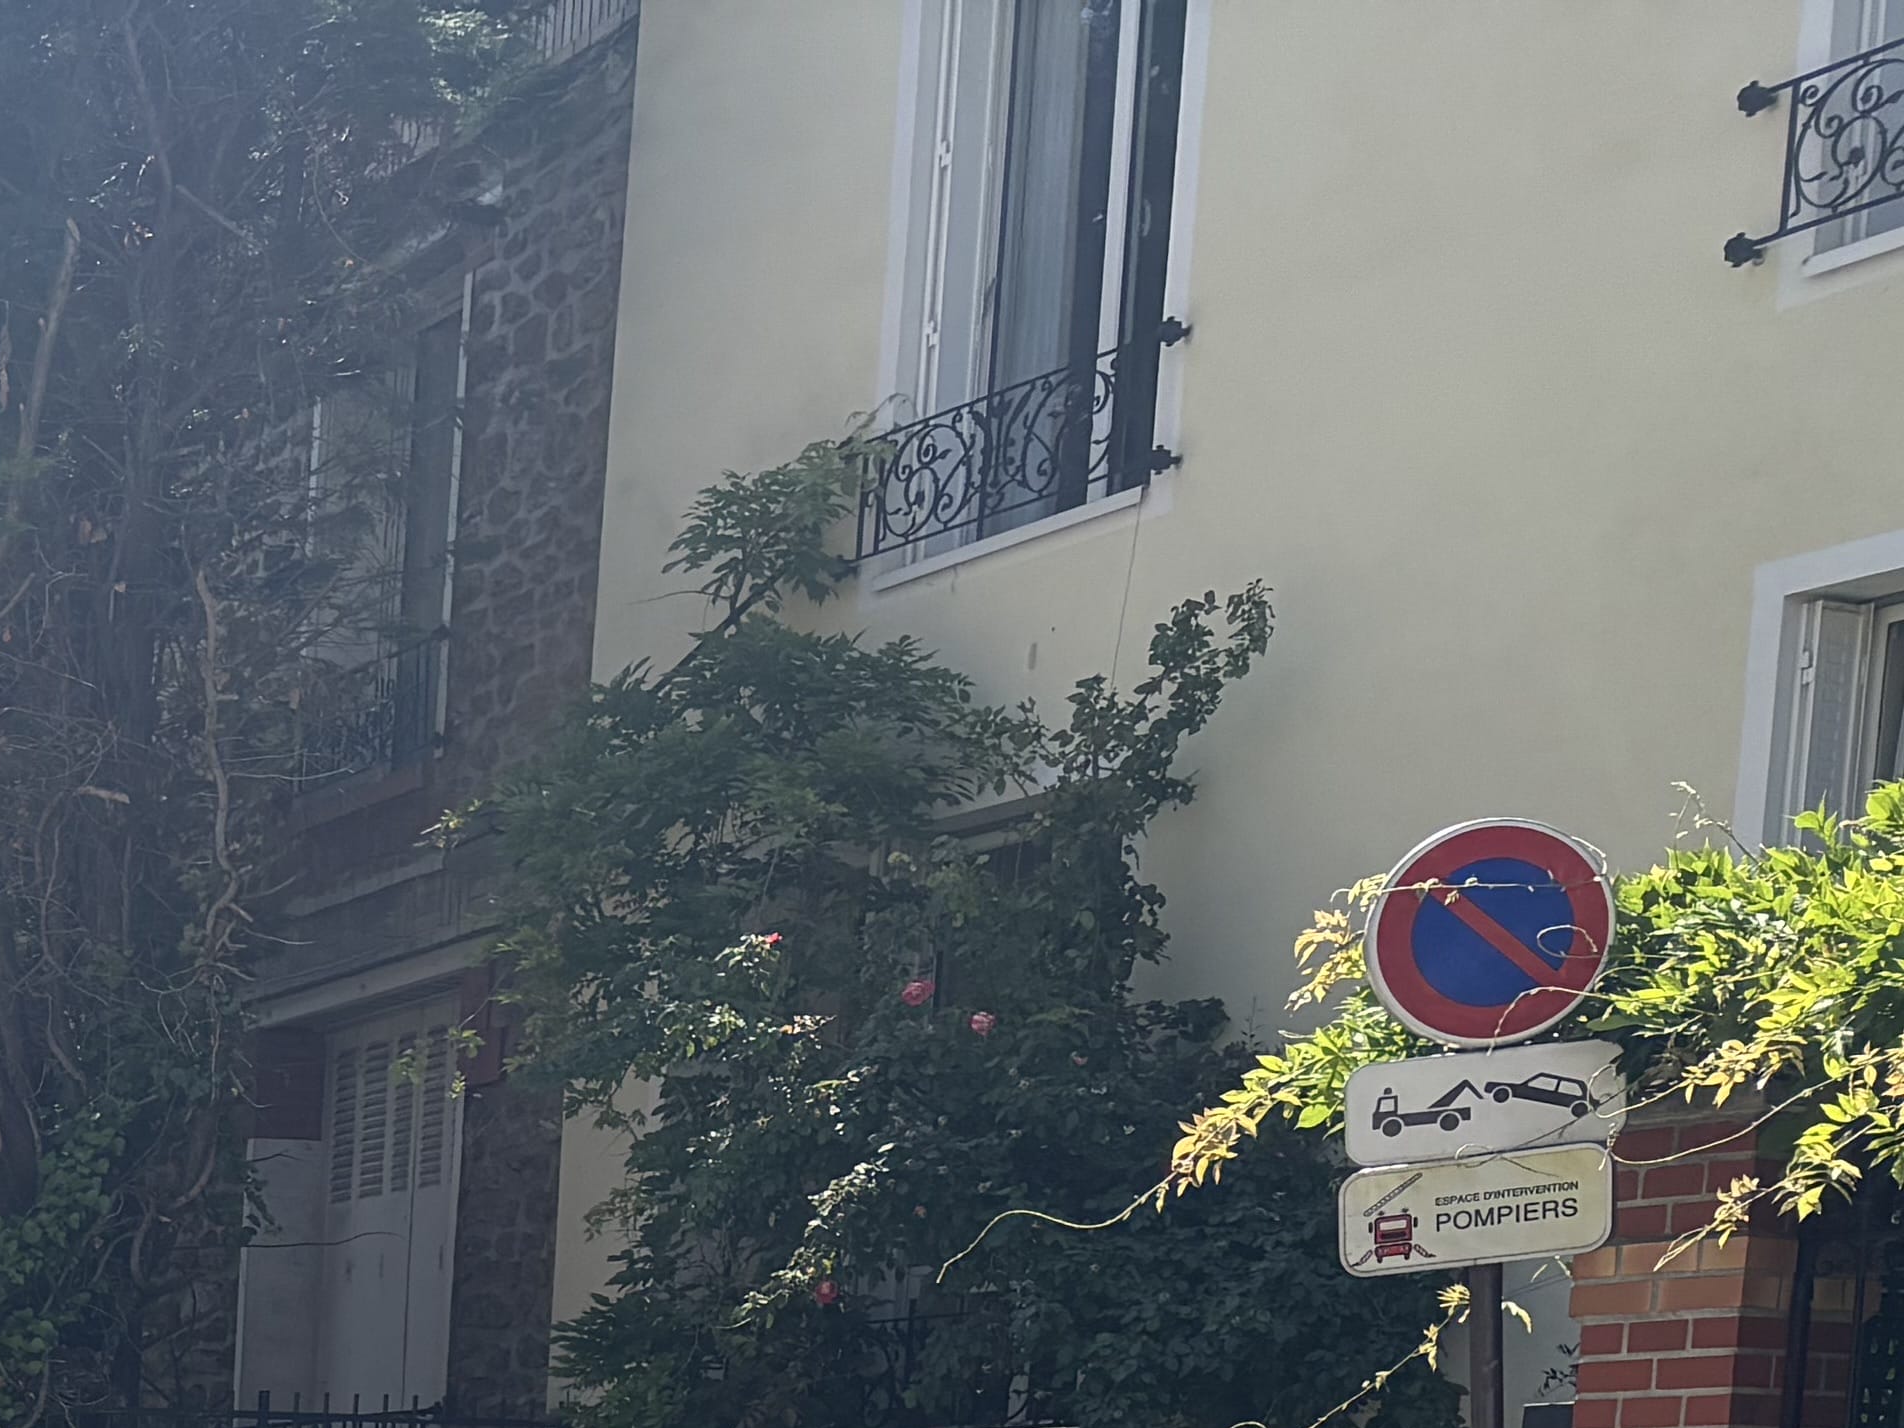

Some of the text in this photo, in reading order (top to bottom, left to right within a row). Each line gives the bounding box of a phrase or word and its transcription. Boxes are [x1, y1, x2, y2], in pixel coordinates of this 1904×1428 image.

[1435, 1181, 1579, 1206] ESPACE D'INTERVENTION
[1436, 1198, 1578, 1232] POMPIERS
